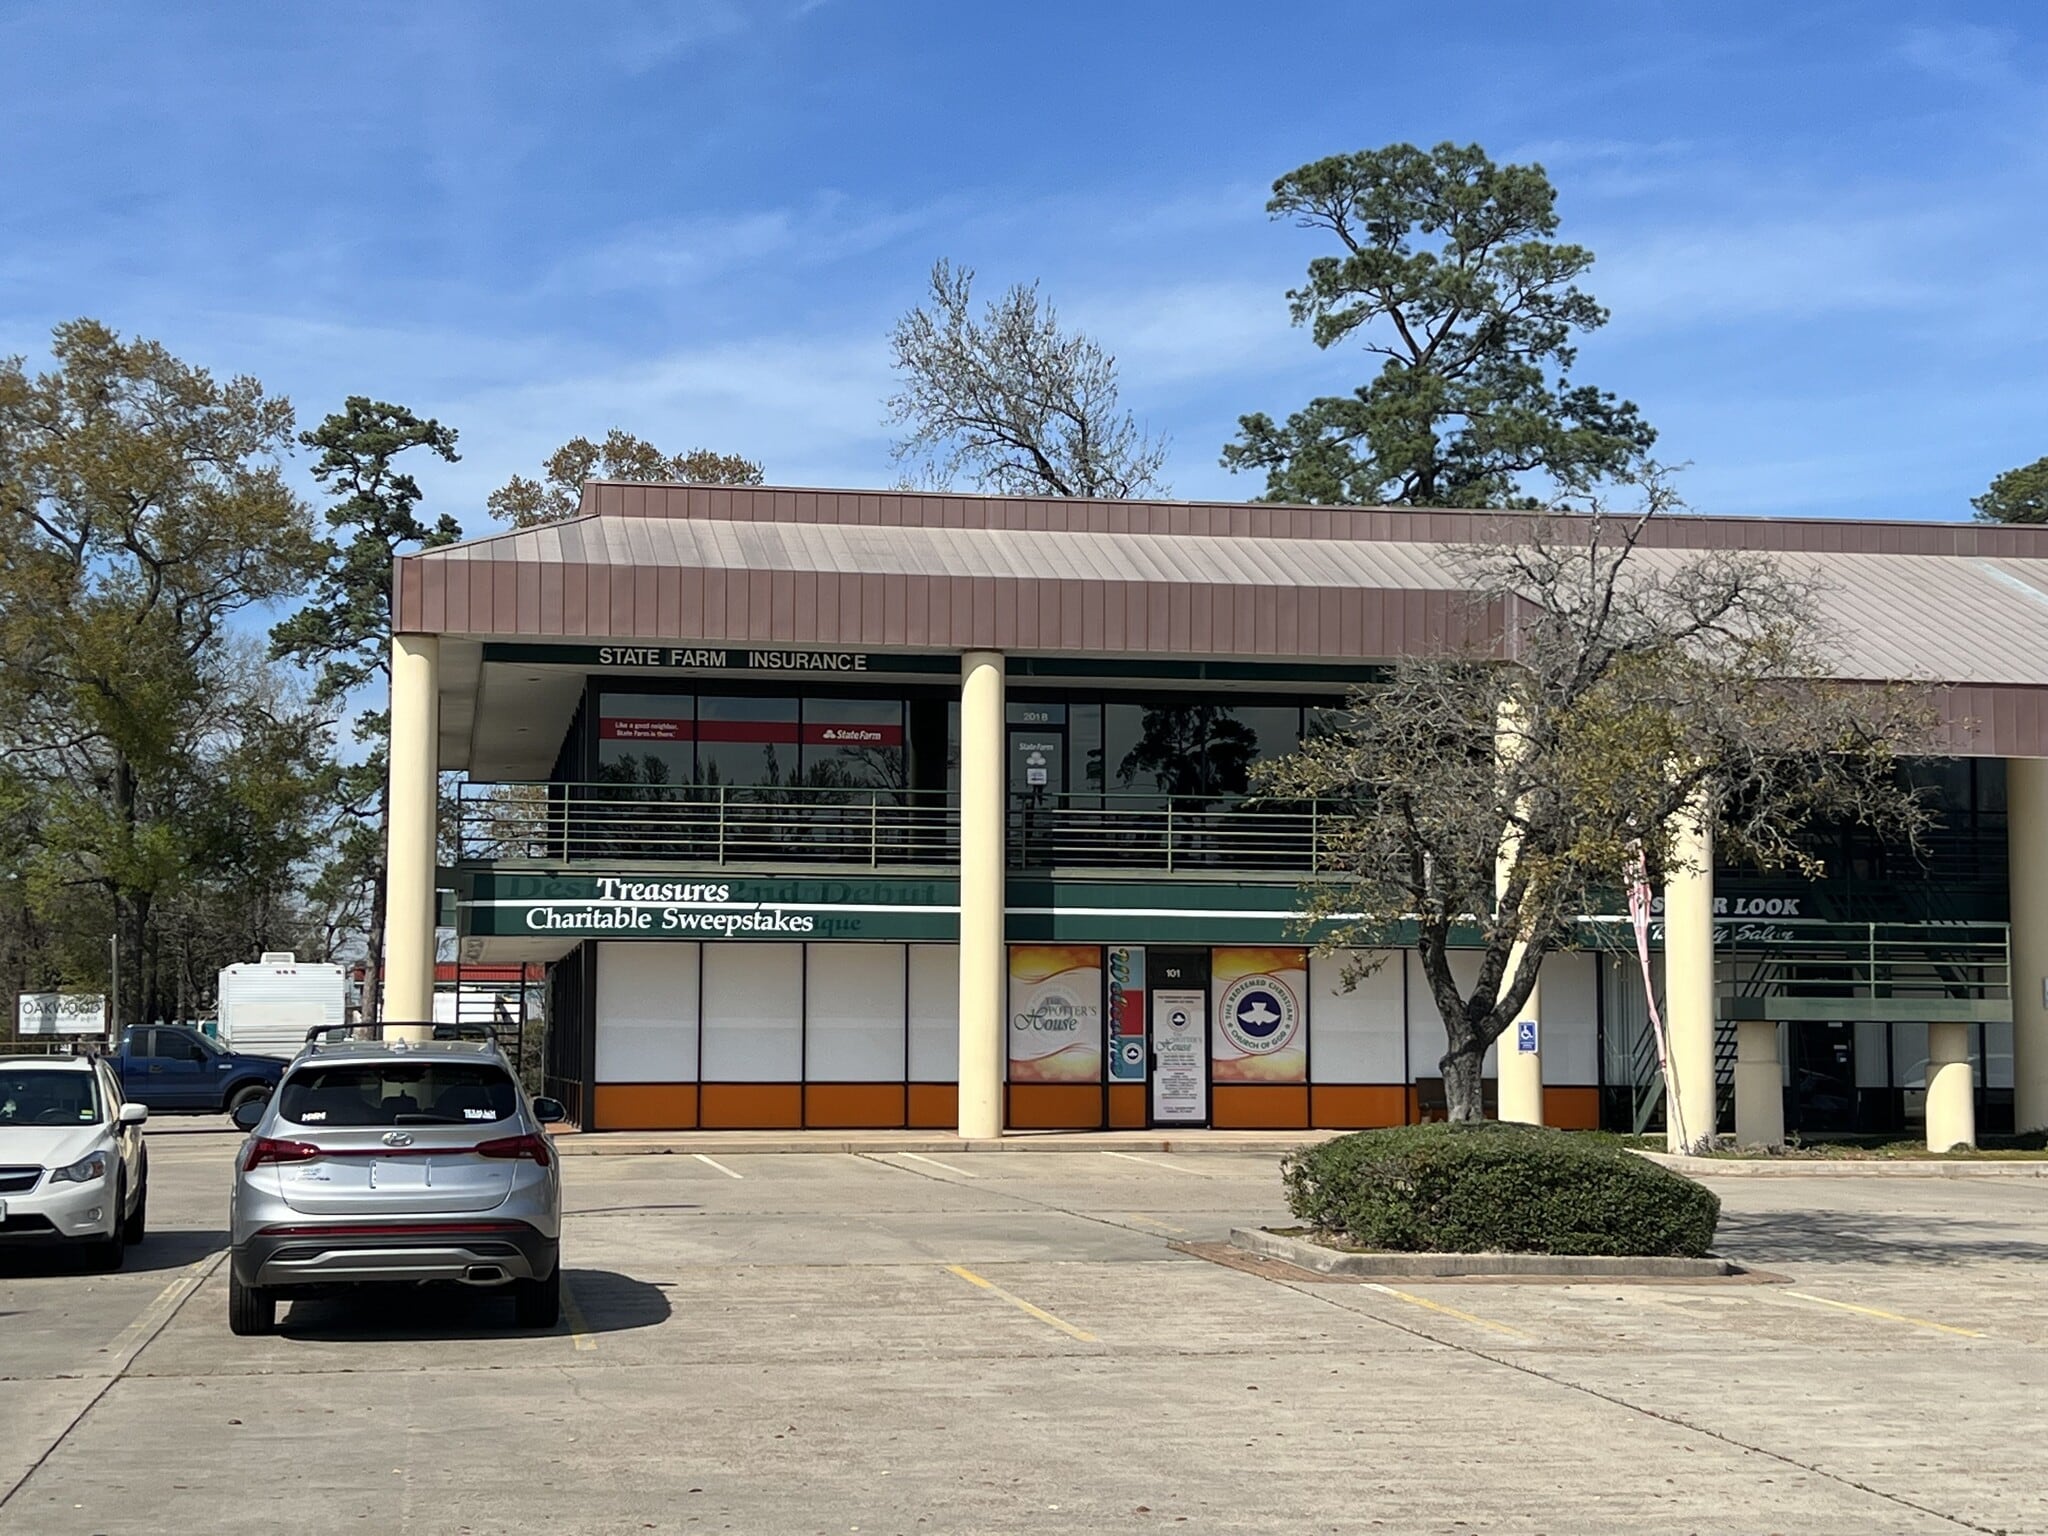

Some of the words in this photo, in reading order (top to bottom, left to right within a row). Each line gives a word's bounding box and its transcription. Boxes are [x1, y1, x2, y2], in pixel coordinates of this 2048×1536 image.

[599, 647, 660, 666] STATE
[671, 649, 726, 667] FARM
[749, 651, 867, 671] INSURANCE
[597, 877, 730, 902] Treasures
[1734, 898, 1800, 915] LOOK
[526, 907, 652, 929] Charitable
[661, 908, 814, 937] Sweepstakes
[1166, 969, 1180, 978] 101
[1048, 1005, 1097, 1016] POTTER'S
[1229, 980, 1266, 1002] REDEEMED
[1268, 982, 1293, 1021] CHRISTIAN
[1013, 1006, 1078, 1031] House
[1231, 1029, 1259, 1048] CHURCH
[1272, 1030, 1287, 1045] GOD
